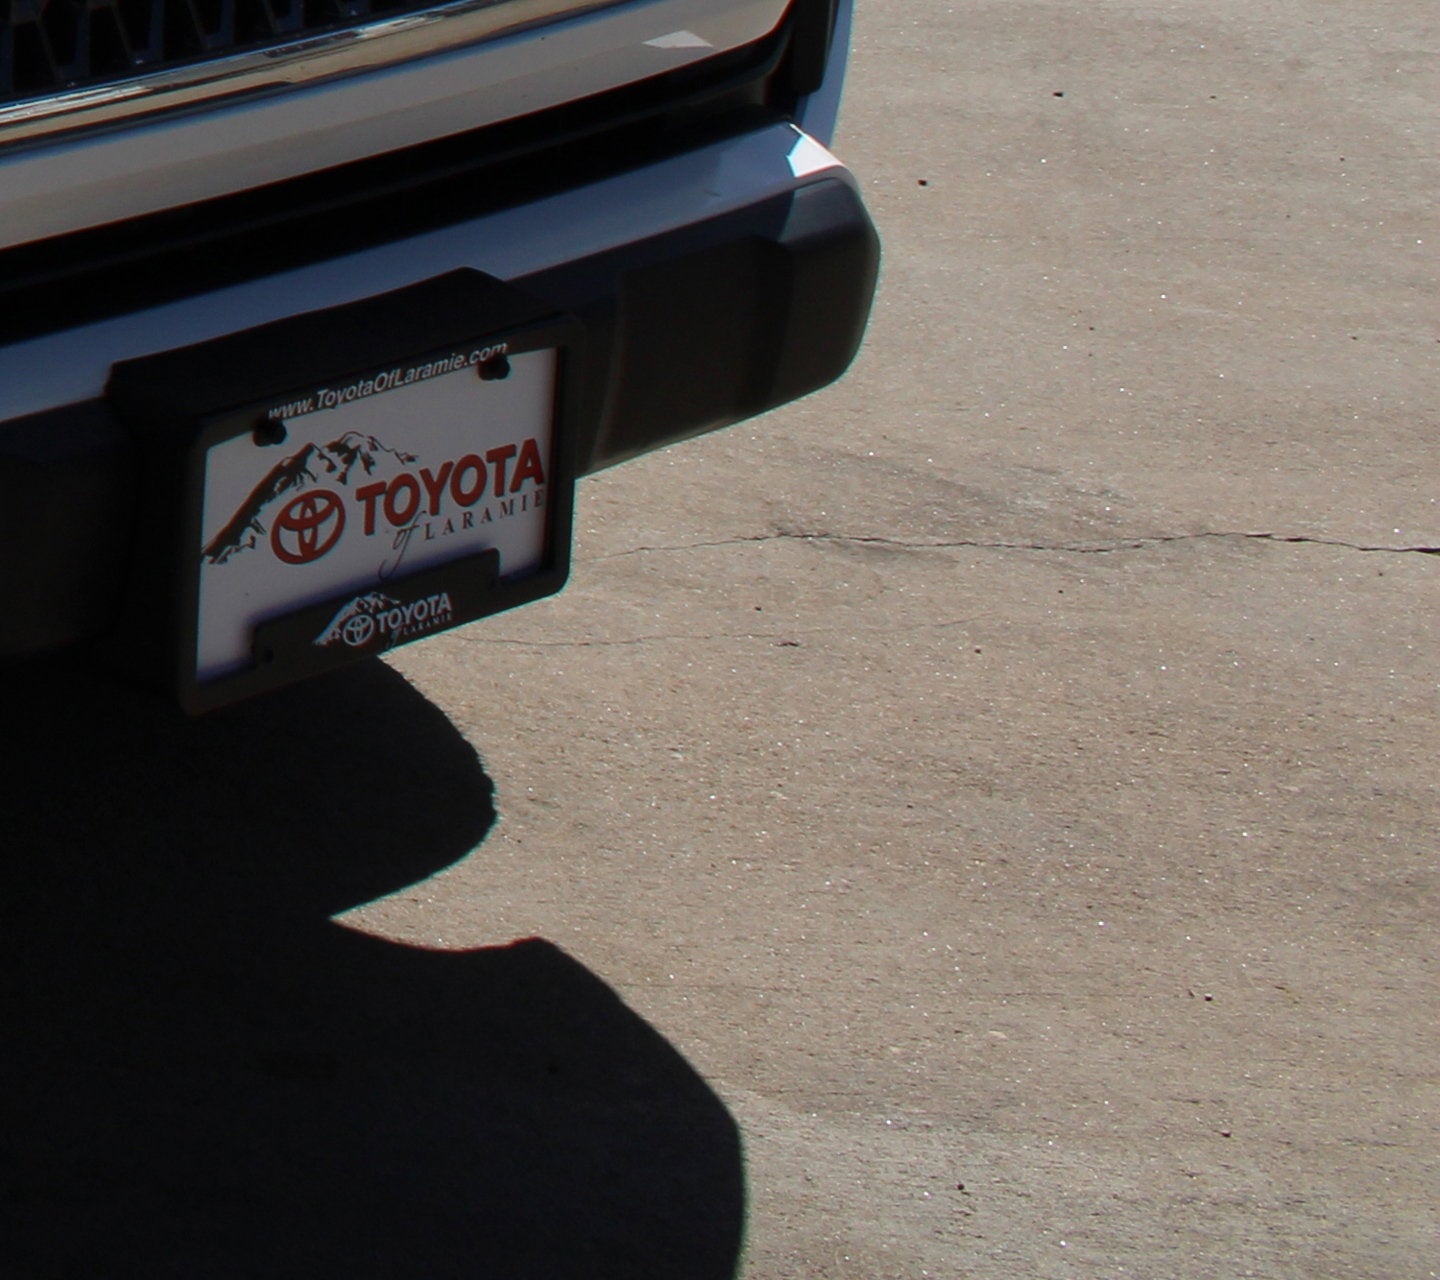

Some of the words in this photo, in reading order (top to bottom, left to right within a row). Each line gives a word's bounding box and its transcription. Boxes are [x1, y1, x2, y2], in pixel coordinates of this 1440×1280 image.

[268, 342, 508, 420] www.ToyotaOfLaramie.com
[356, 438, 545, 536] TOYOTA
[425, 489, 546, 541] LARAMIE
[376, 592, 453, 634] TOYOTA
